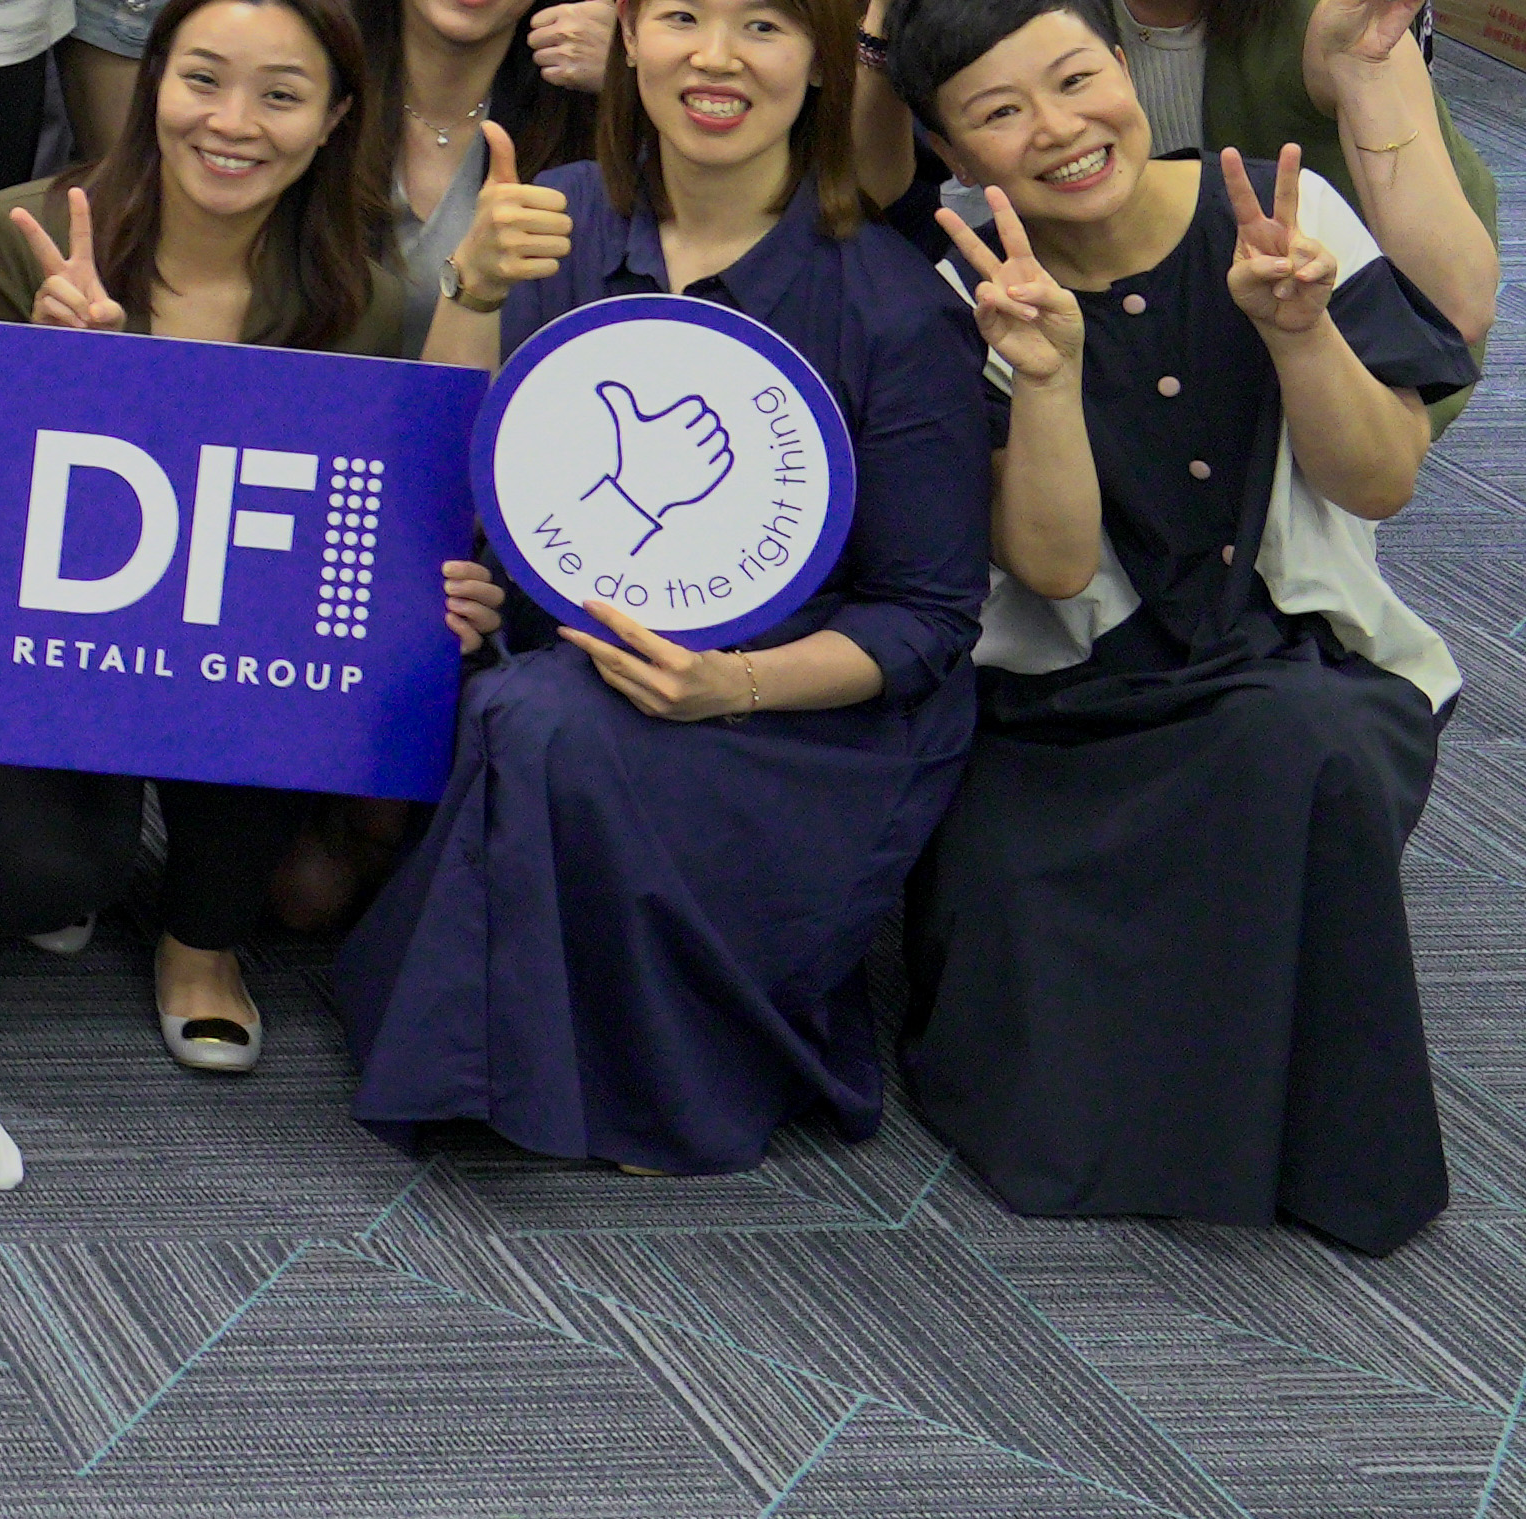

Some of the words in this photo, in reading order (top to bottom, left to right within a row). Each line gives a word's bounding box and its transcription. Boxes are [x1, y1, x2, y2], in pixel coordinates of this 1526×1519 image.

[751, 385, 807, 485] thing
[17, 427, 385, 640] DFI
[532, 513, 583, 575] We
[737, 499, 804, 582] right
[594, 573, 649, 607] do
[665, 574, 732, 608] the
[12, 634, 176, 680] RETAIL
[199, 650, 366, 693] GROUP
